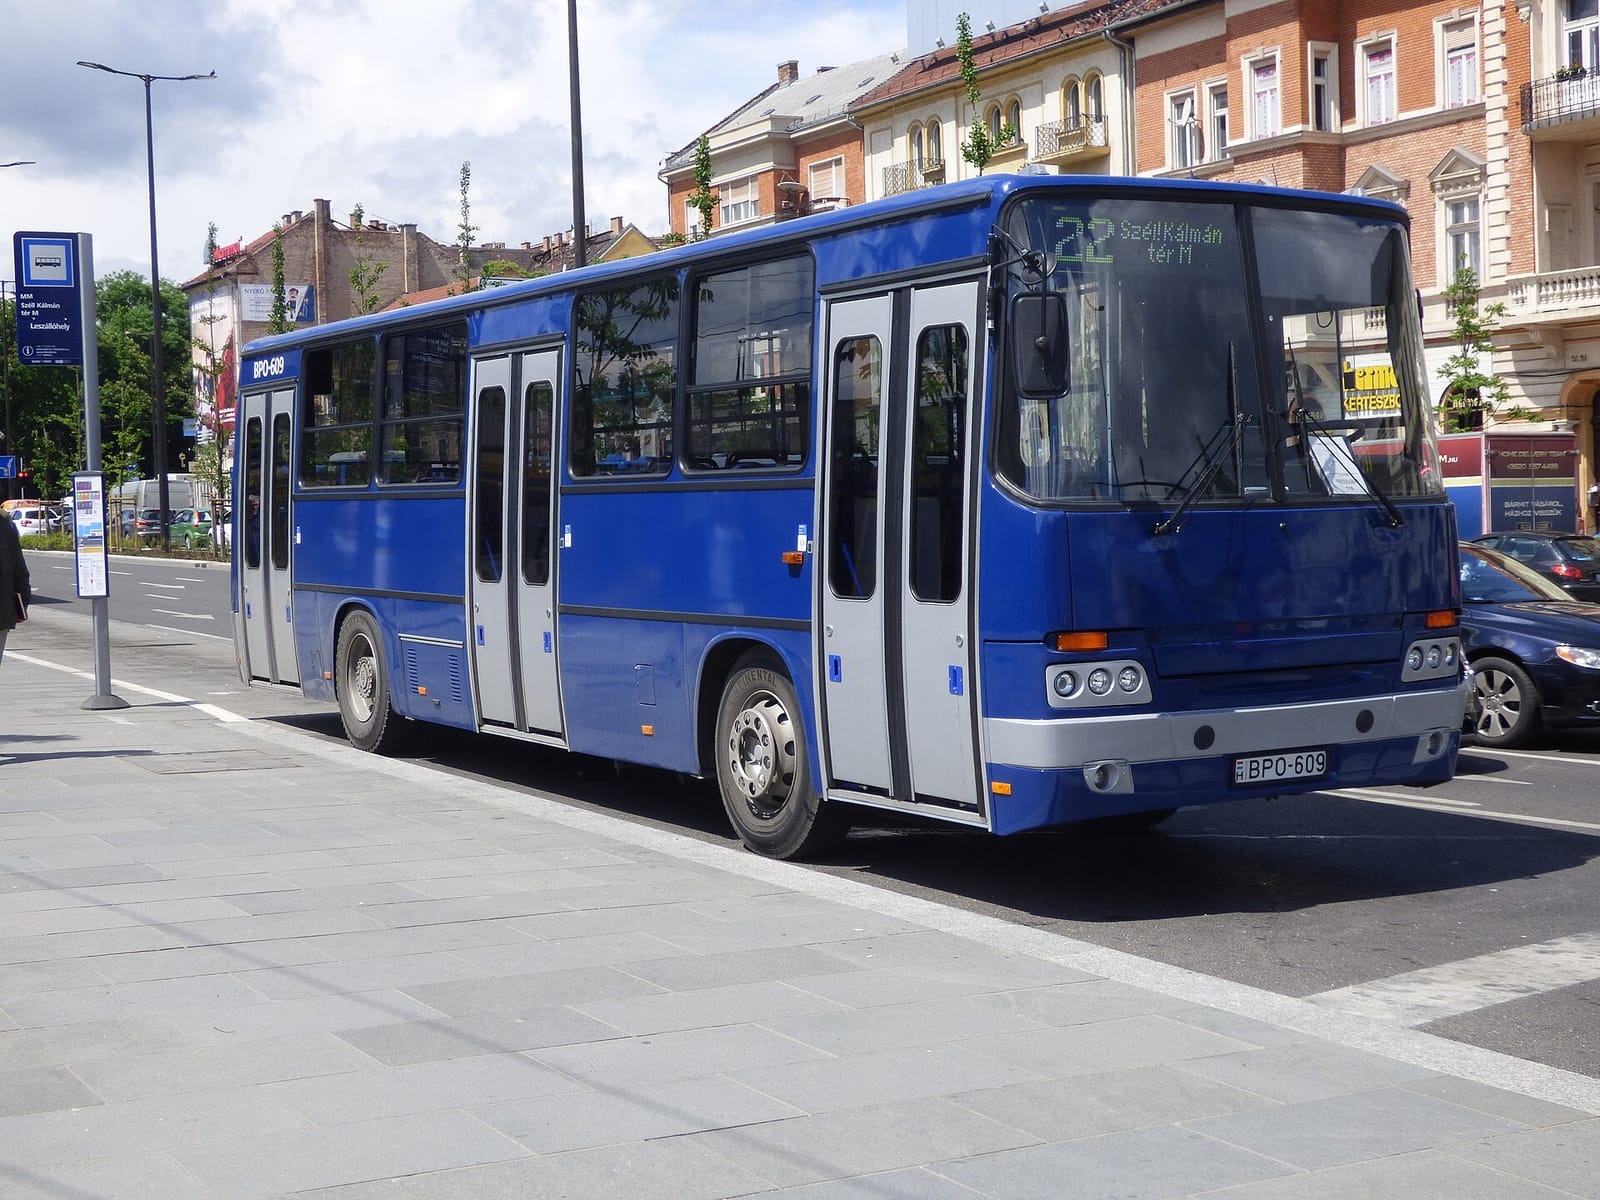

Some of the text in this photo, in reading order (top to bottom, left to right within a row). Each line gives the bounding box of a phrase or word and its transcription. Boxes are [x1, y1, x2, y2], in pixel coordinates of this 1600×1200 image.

[1055, 216, 1115, 264] 22
[1120, 219, 1223, 244] Széll Kálmán
[1147, 243, 1192, 264] tér M
[30, 323, 70, 331] Leszállóhely
[253, 356, 285, 379] BPO-609
[1236, 753, 1325, 780] H BPO-609
